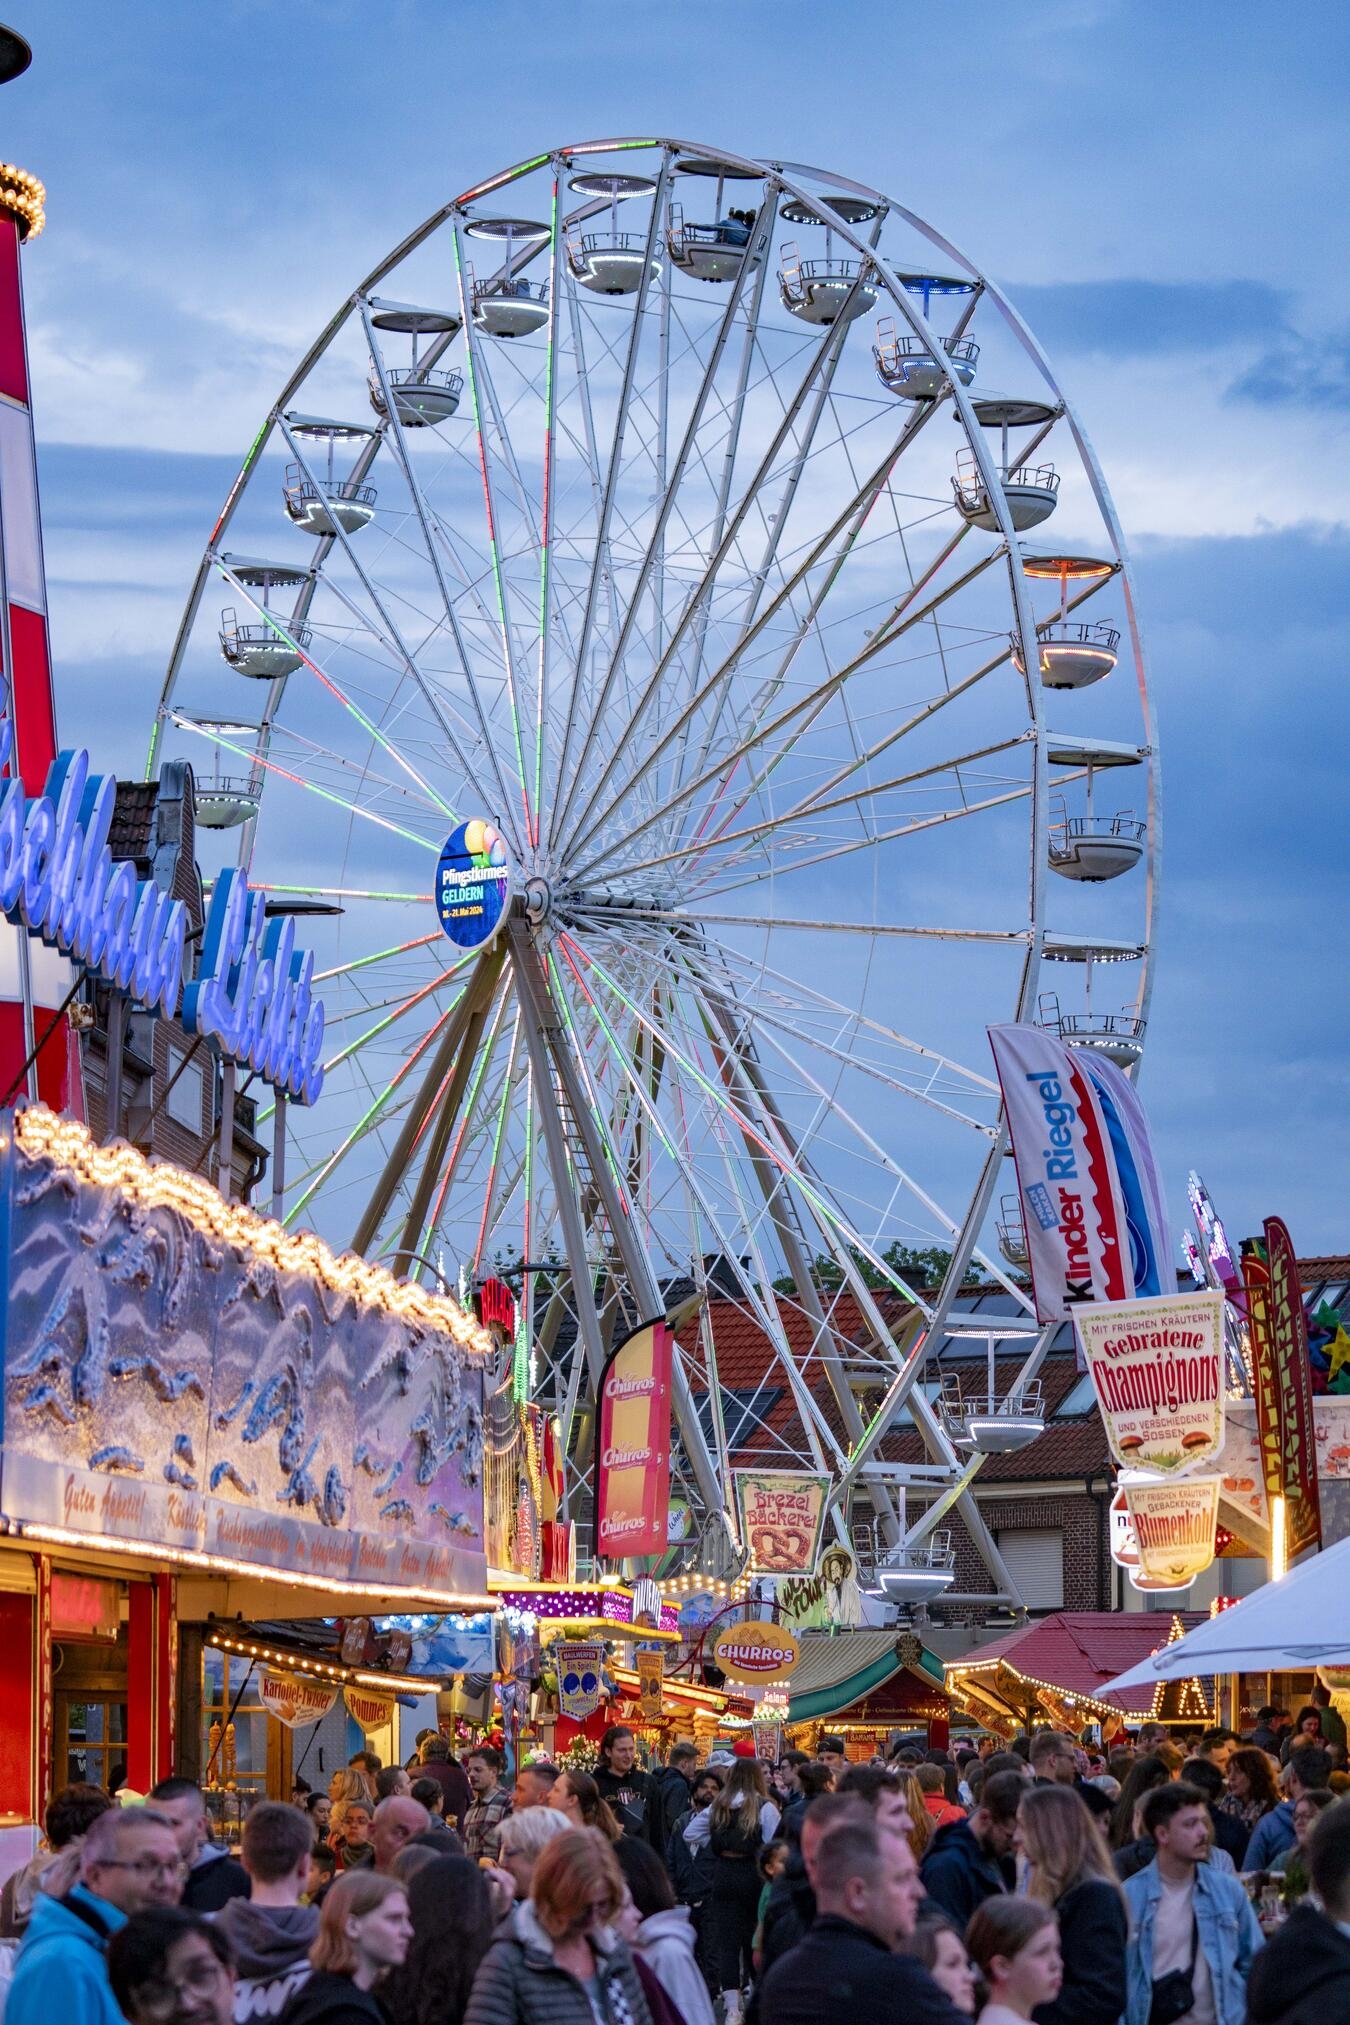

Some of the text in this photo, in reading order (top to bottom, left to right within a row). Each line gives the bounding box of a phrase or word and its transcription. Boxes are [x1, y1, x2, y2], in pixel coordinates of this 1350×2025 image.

[442, 865, 507, 887] Pfingstkirmes
[442, 885, 484, 904] GELDERN
[1026, 1071, 1078, 1181] Riegel
[1112, 1319, 1158, 1332] FRISCHEN
[1160, 1313, 1211, 1327] KRÄUTERN
[1103, 1329, 1204, 1359] Gebratene
[606, 1376, 656, 1398] Churros
[1092, 1351, 1219, 1416] Champignons
[1117, 1413, 1209, 1433] UND VERSCHIEDENEN
[1142, 1427, 1186, 1442] SOSSEN
[602, 1447, 651, 1468] Churros
[753, 1491, 809, 1512] Brezel
[1147, 1500, 1201, 1513] GEBACKENER
[600, 1515, 646, 1538] Churros
[746, 1507, 817, 1529] Bäckerei
[1134, 1507, 1214, 1549] Blumenkohl
[717, 1644, 794, 1663] CHURROS
[350, 1693, 387, 1723] Pommes
